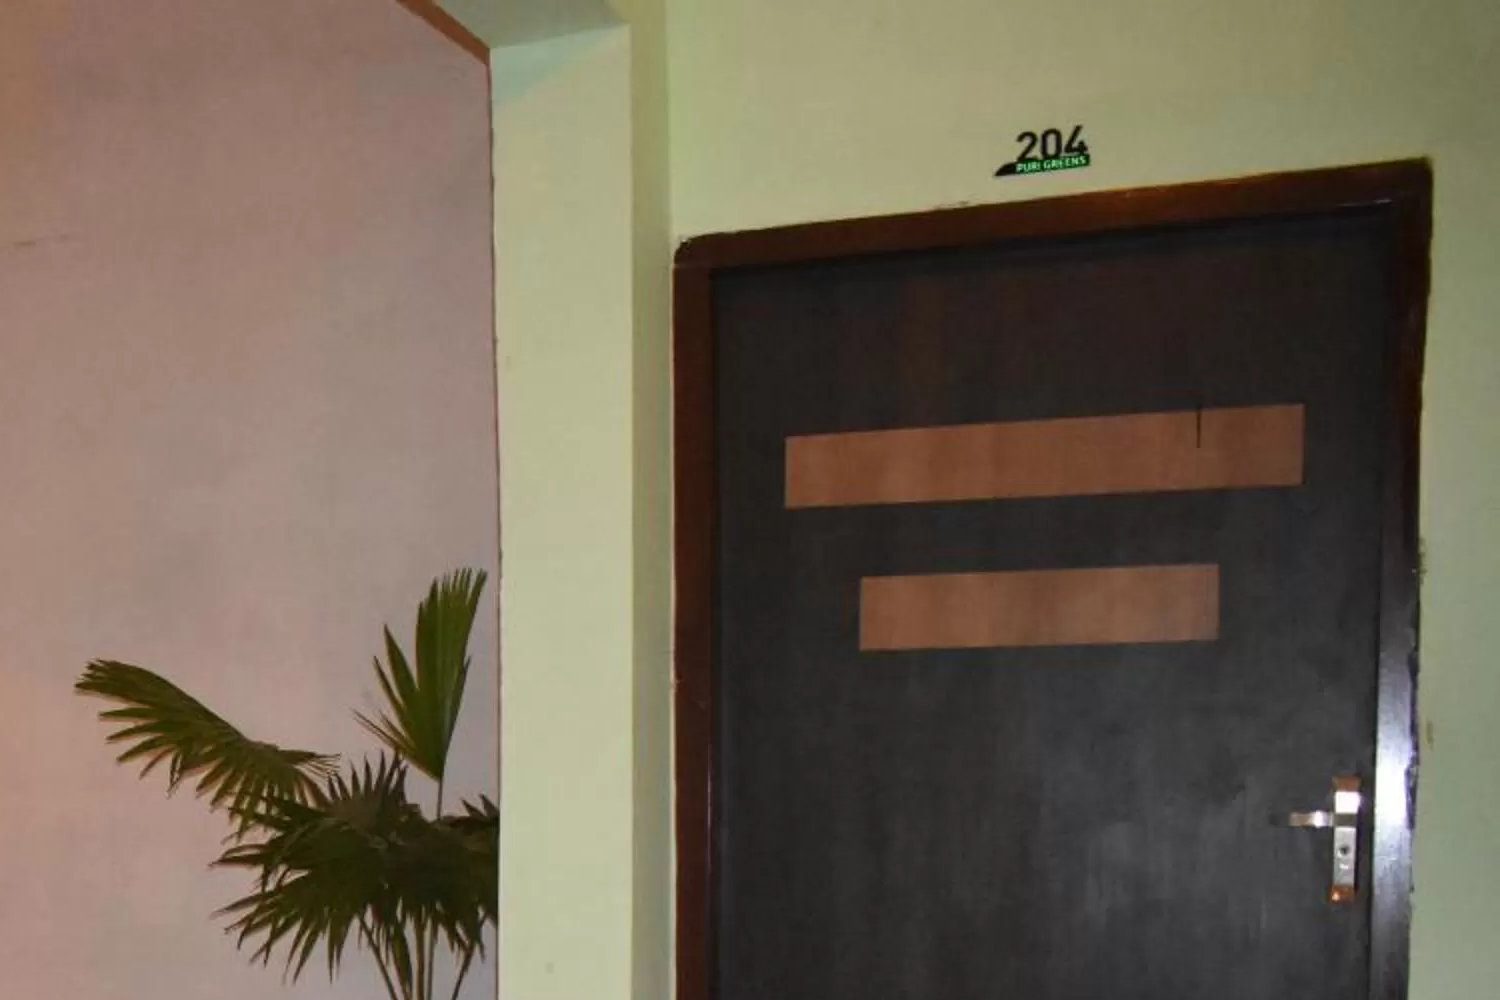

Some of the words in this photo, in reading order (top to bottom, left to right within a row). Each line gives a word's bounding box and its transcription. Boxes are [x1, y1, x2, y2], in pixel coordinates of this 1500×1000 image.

[1016, 125, 1087, 160] 204
[1016, 161, 1041, 173] PURI
[1044, 156, 1086, 169] GREENS
